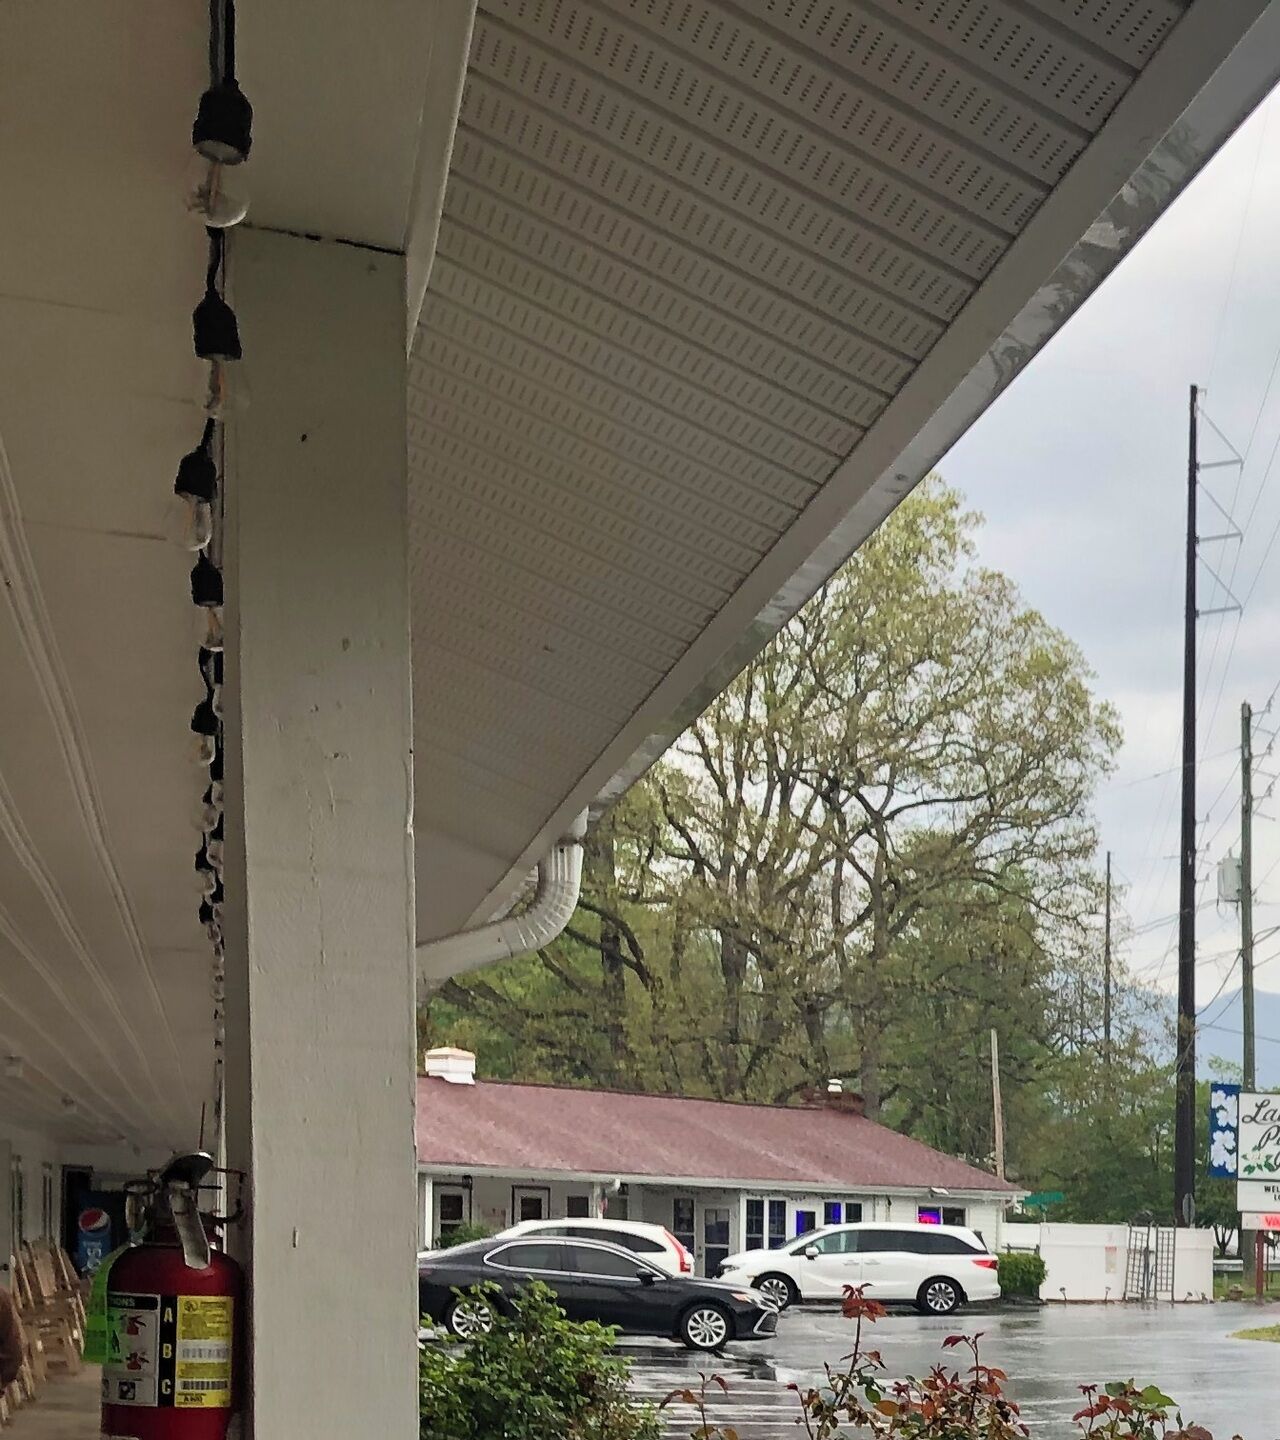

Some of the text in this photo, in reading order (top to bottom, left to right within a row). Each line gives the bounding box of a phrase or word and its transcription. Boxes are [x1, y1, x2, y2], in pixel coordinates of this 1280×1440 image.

[164, 1307, 173, 1322] A
[162, 1343, 172, 1358] B
[162, 1379, 171, 1394] C
